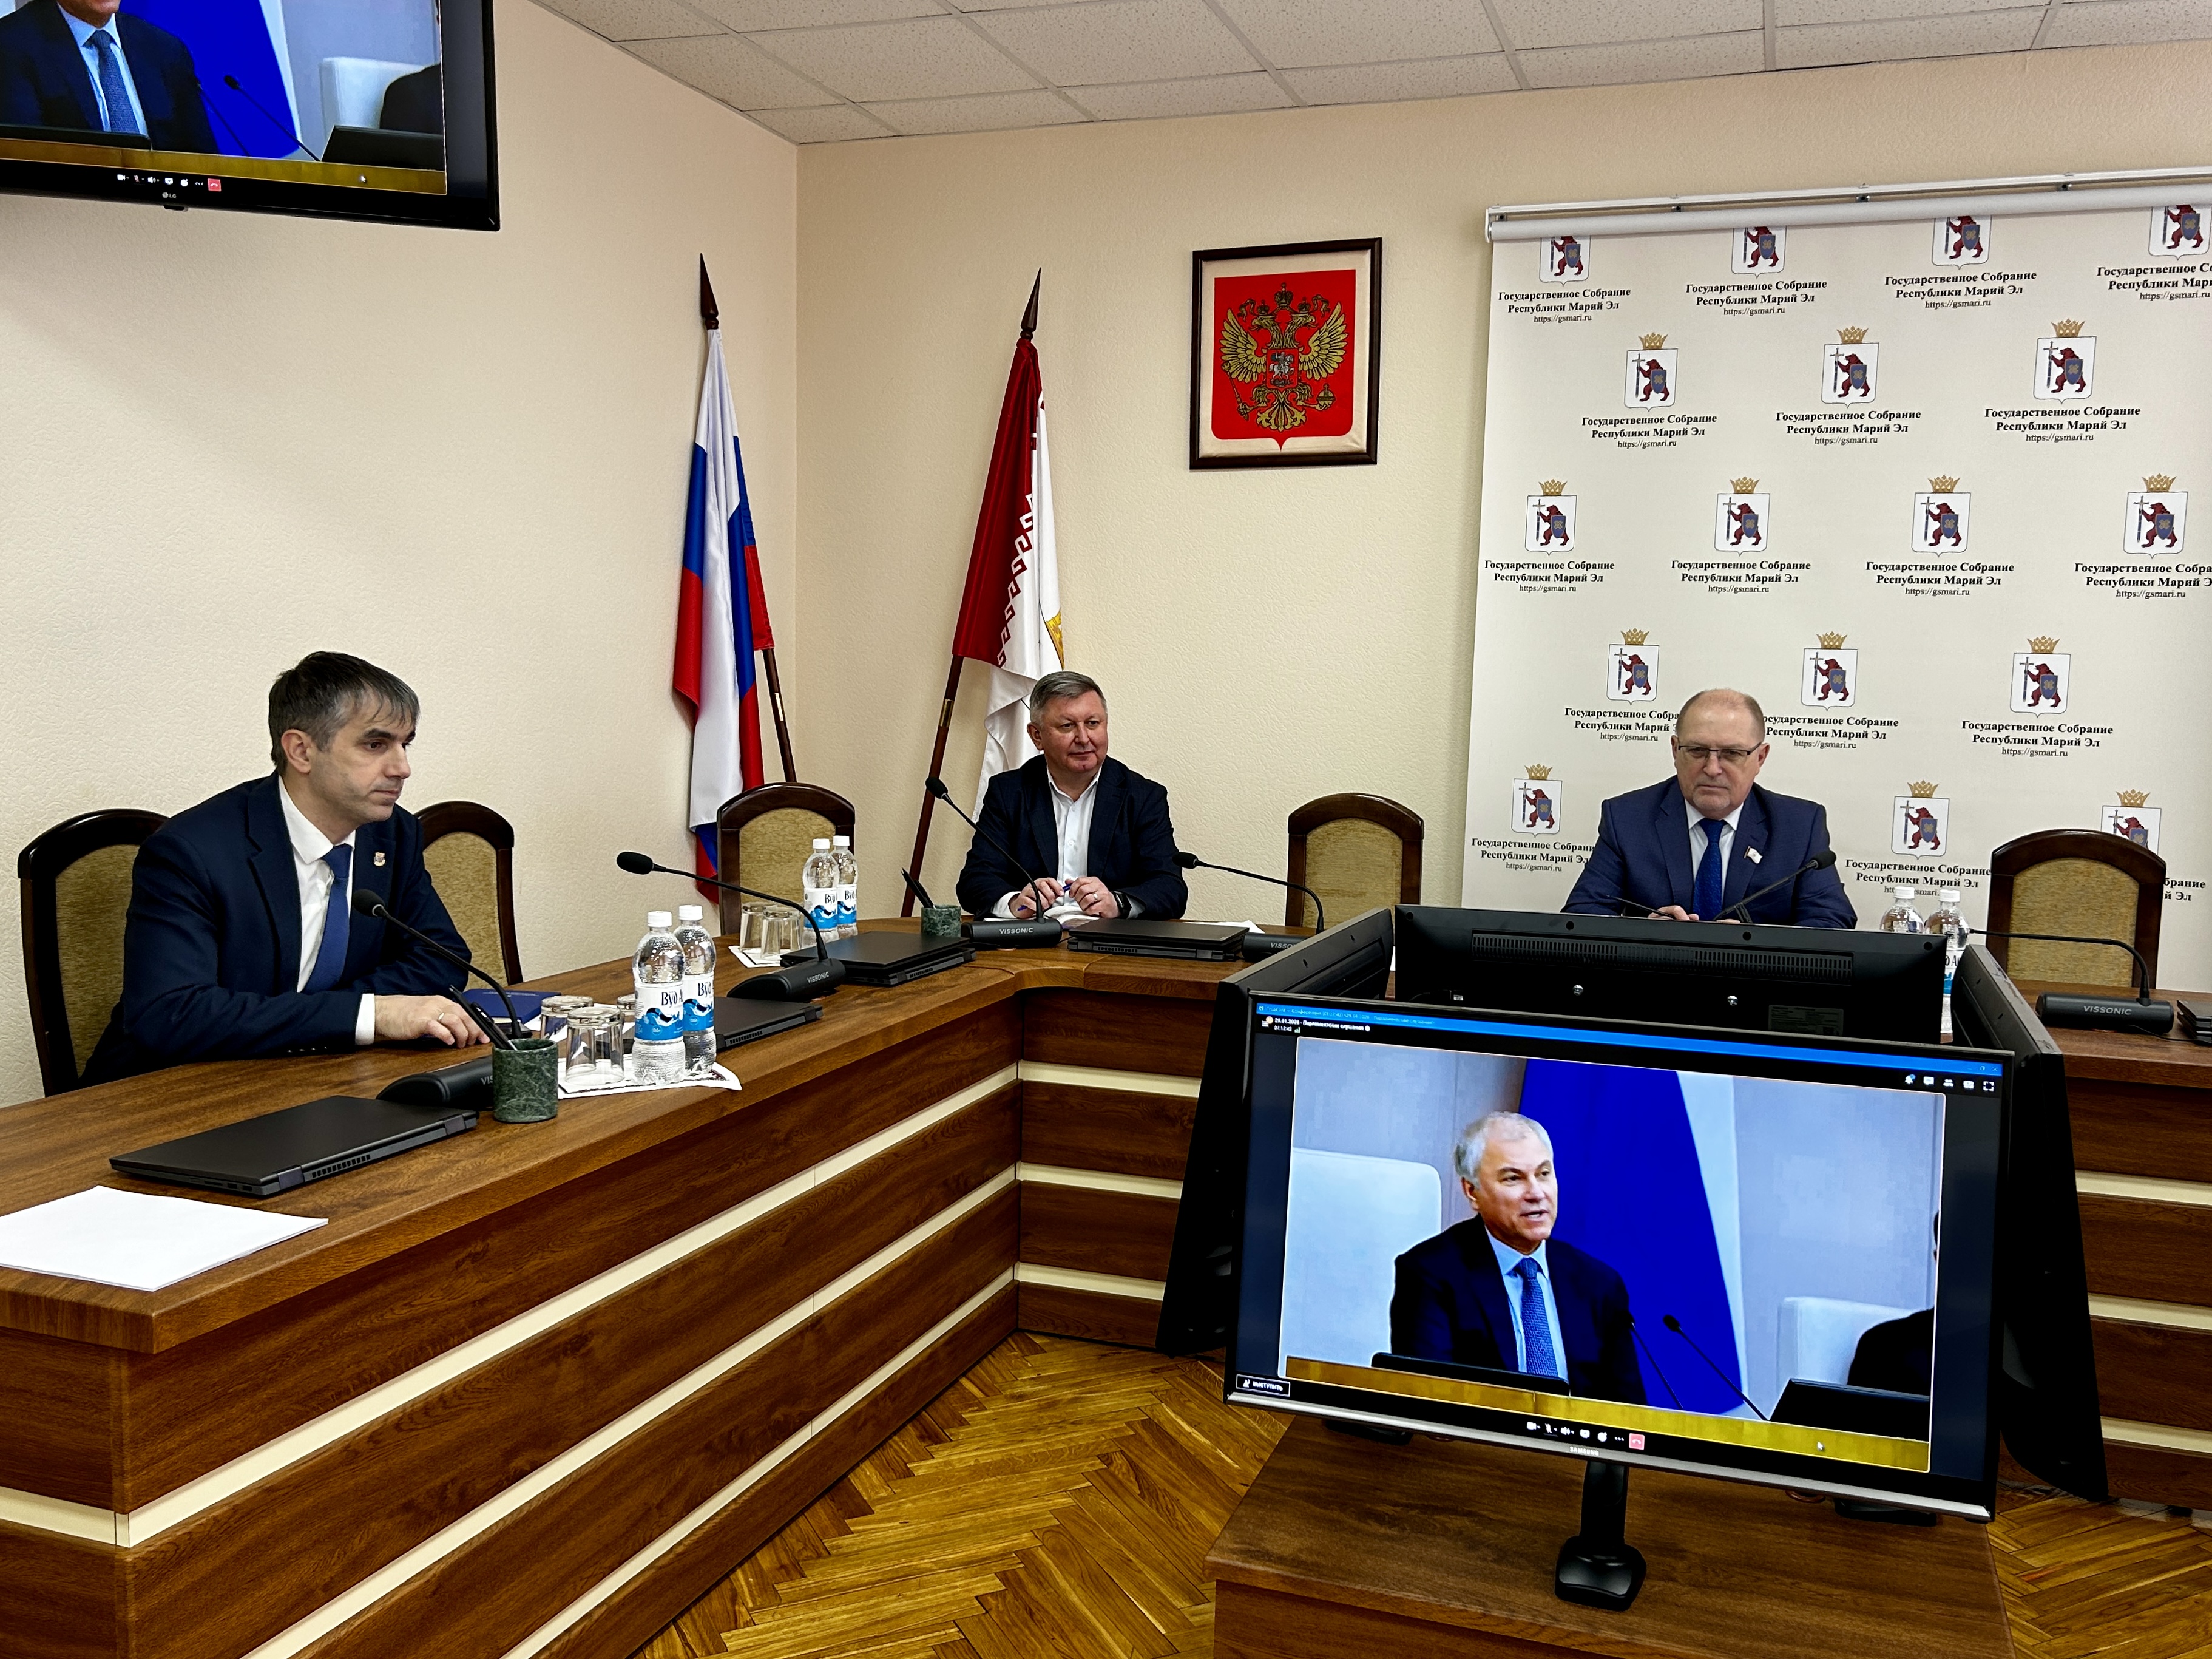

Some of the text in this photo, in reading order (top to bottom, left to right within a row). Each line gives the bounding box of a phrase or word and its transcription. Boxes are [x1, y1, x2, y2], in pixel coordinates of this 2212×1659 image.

[2097, 266, 2196, 278] Государственное
[1885, 272, 2037, 287] Государственное Собрание
[2108, 279, 2178, 291] Республики
[1686, 280, 1827, 294] Государственное Собрание
[1896, 285, 2023, 300] Республики Марий Эл
[1498, 288, 1631, 302] Государственное Собрание
[1696, 294, 1815, 307] Республики Марий Эл
[1508, 301, 1619, 314] Республики Марий Эл
[1776, 410, 1921, 422] Государственное Собрание
[1984, 407, 2140, 419] Государственное Собрание
[1582, 415, 1717, 427] Государственное Собрание
[1995, 420, 2126, 432] Республики Марий Эл
[1592, 429, 1649, 439] Республики
[1653, 427, 1688, 438] Марий
[1787, 424, 1908, 436] Республики Марий Эл
[1485, 560, 1614, 571] Государственное Собрание
[1671, 560, 1811, 571] Государственное Собрание
[1866, 562, 2014, 574] Государственное Собрание
[2075, 563, 2212, 575] Государственное Собра
[1494, 573, 1551, 583] Республики
[1554, 574, 1587, 584] Марий
[1682, 573, 1742, 583] Республики
[1745, 574, 1781, 584] Марий
[1876, 575, 2001, 586] Республики Марий Эл
[2086, 577, 2154, 588] Республики
[2157, 578, 2200, 589] Марий
[1565, 708, 1679, 721] Государственное Собра
[1574, 721, 1632, 731] Республики
[1635, 722, 1669, 733] Марий
[1764, 716, 1899, 728] осударственное Собрание
[1962, 721, 2113, 735] Государственное Собрание
[1766, 727, 1886, 740] Республики Марий Эл
[1972, 734, 2100, 748] Республики Марий Эл
[1472, 838, 1551, 849] Государственное
[1481, 850, 1537, 861] Республики
[1540, 853, 1573, 864] Марий
[1845, 859, 1935, 872] Государственное
[1856, 872, 1978, 889] Республики Марий Эл
[2175, 892, 2191, 901] Эл
[807, 971, 830, 983] VISSONIC
[2083, 1006, 2132, 1015] VISSONIC
[1253, 1381, 1283, 1391] ВЫСТУПИТЬ
[1569, 1446, 1600, 1456] SAMSUNG
